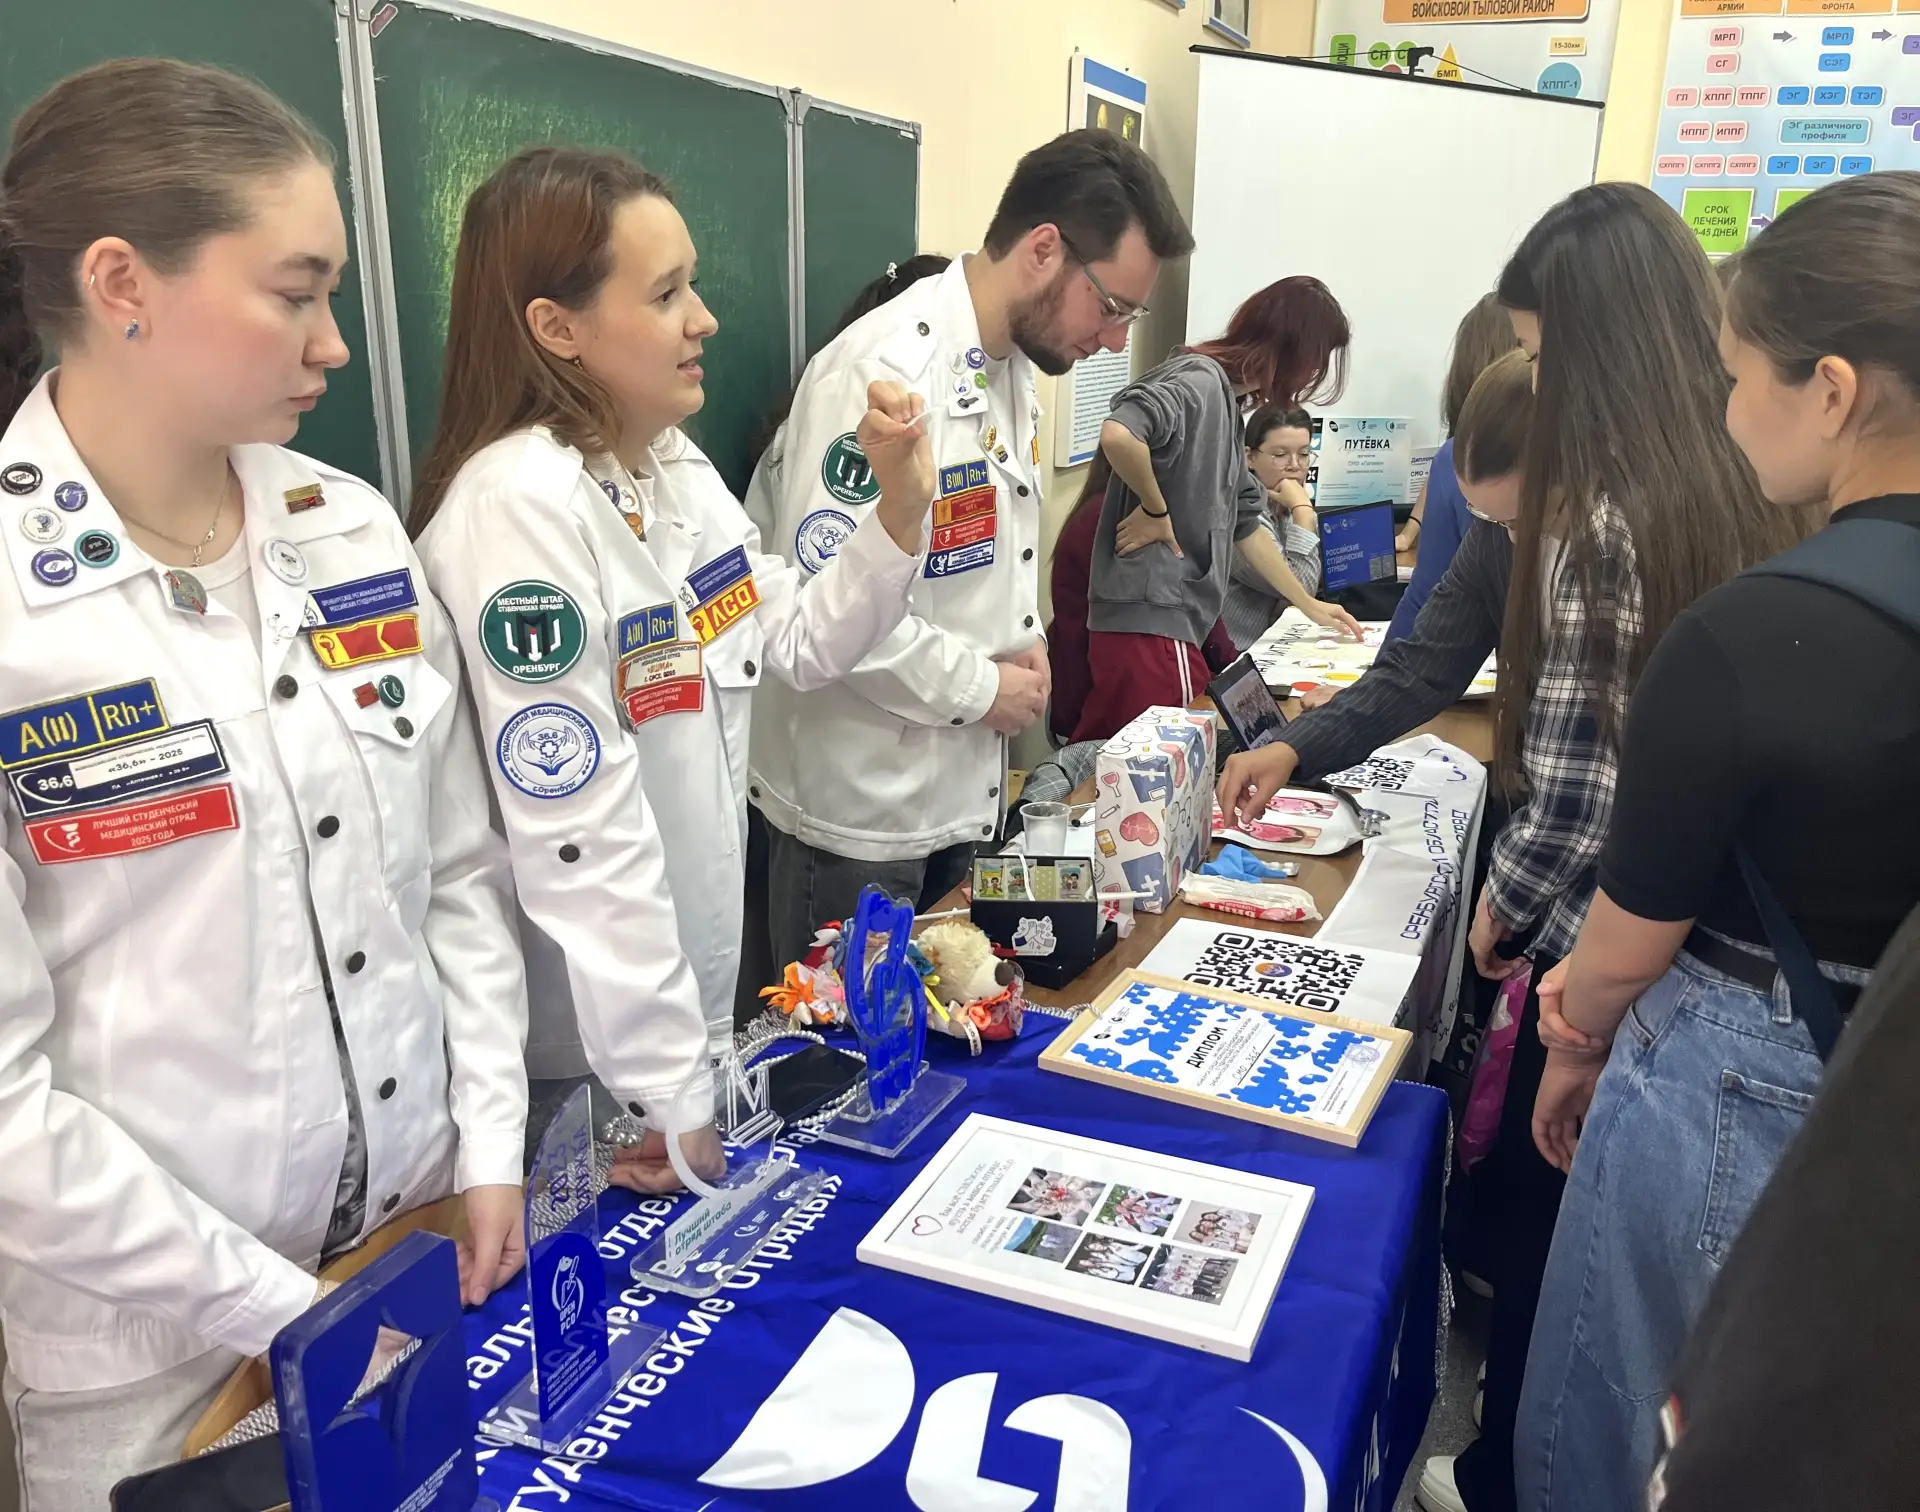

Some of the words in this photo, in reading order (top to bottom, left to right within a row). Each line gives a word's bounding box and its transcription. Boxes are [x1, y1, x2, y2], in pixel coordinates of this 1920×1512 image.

[1412, 1, 1470, 17] ВОЙСКОВОЙ
[1473, 0, 1520, 14] ТЫЛОВОЙ
[1522, 0, 1555, 13] РАЙОН
[1717, 3, 1744, 11] АРМИИ
[1714, 32, 1736, 42] МРП
[1826, 32, 1849, 40] МРП
[1715, 59, 1728, 68] СГ
[1437, 70, 1458, 78] БМП
[1542, 80, 1578, 90] ХППГ-1
[1704, 92, 1731, 101] ХППГ
[1740, 92, 1766, 100] ТППГ
[1786, 92, 1801, 100] ЭГ
[1820, 92, 1840, 100] ХЭГ
[1681, 128, 1709, 136] НППГ
[1716, 128, 1744, 136] ИППГ
[1789, 121, 1802, 130] ЭГ
[1804, 123, 1862, 132] различного
[1801, 132, 1847, 141] профиля
[1704, 206, 1730, 214] СРОК
[1693, 216, 1737, 226] ЛЕЧЕНИЯ
[1712, 226, 1738, 237] ДНЕЙ
[1344, 436, 1390, 449] ПУТЁВКА
[970, 467, 987, 484] Rh+
[832, 484, 864, 499] ОРЕНБУРГ
[496, 595, 538, 606] МЕСТНЫЙ
[540, 595, 564, 604] ШТАБ
[652, 616, 674, 637] Rh+
[512, 663, 560, 674] ОРЕНБУРГ
[20, 712, 78, 754] A(II)
[101, 700, 156, 730] Rh+
[502, 712, 530, 762] СТУДЕНЧЕСКИЙ
[530, 708, 587, 729] МЕДИЦИНСКИЙ
[583, 729, 596, 752] ОТРЯД
[108, 758, 146, 772] «36,6»
[159, 748, 183, 762] 2025
[92, 815, 131, 830] ЛУЧШИЙ
[132, 800, 198, 822] СТУДЕНЧЕСКИЙ
[100, 818, 167, 840] МЕДИЦИНСКИЙ
[169, 812, 197, 826] ОТРЯД
[131, 836, 152, 848] 2025
[153, 830, 176, 842] ГОДА
[1186, 1026, 1228, 1069] ДИПЛОМ
[674, 1208, 710, 1245] Лучший
[675, 1228, 702, 1255] отряд
[704, 1202, 732, 1232] штаба
